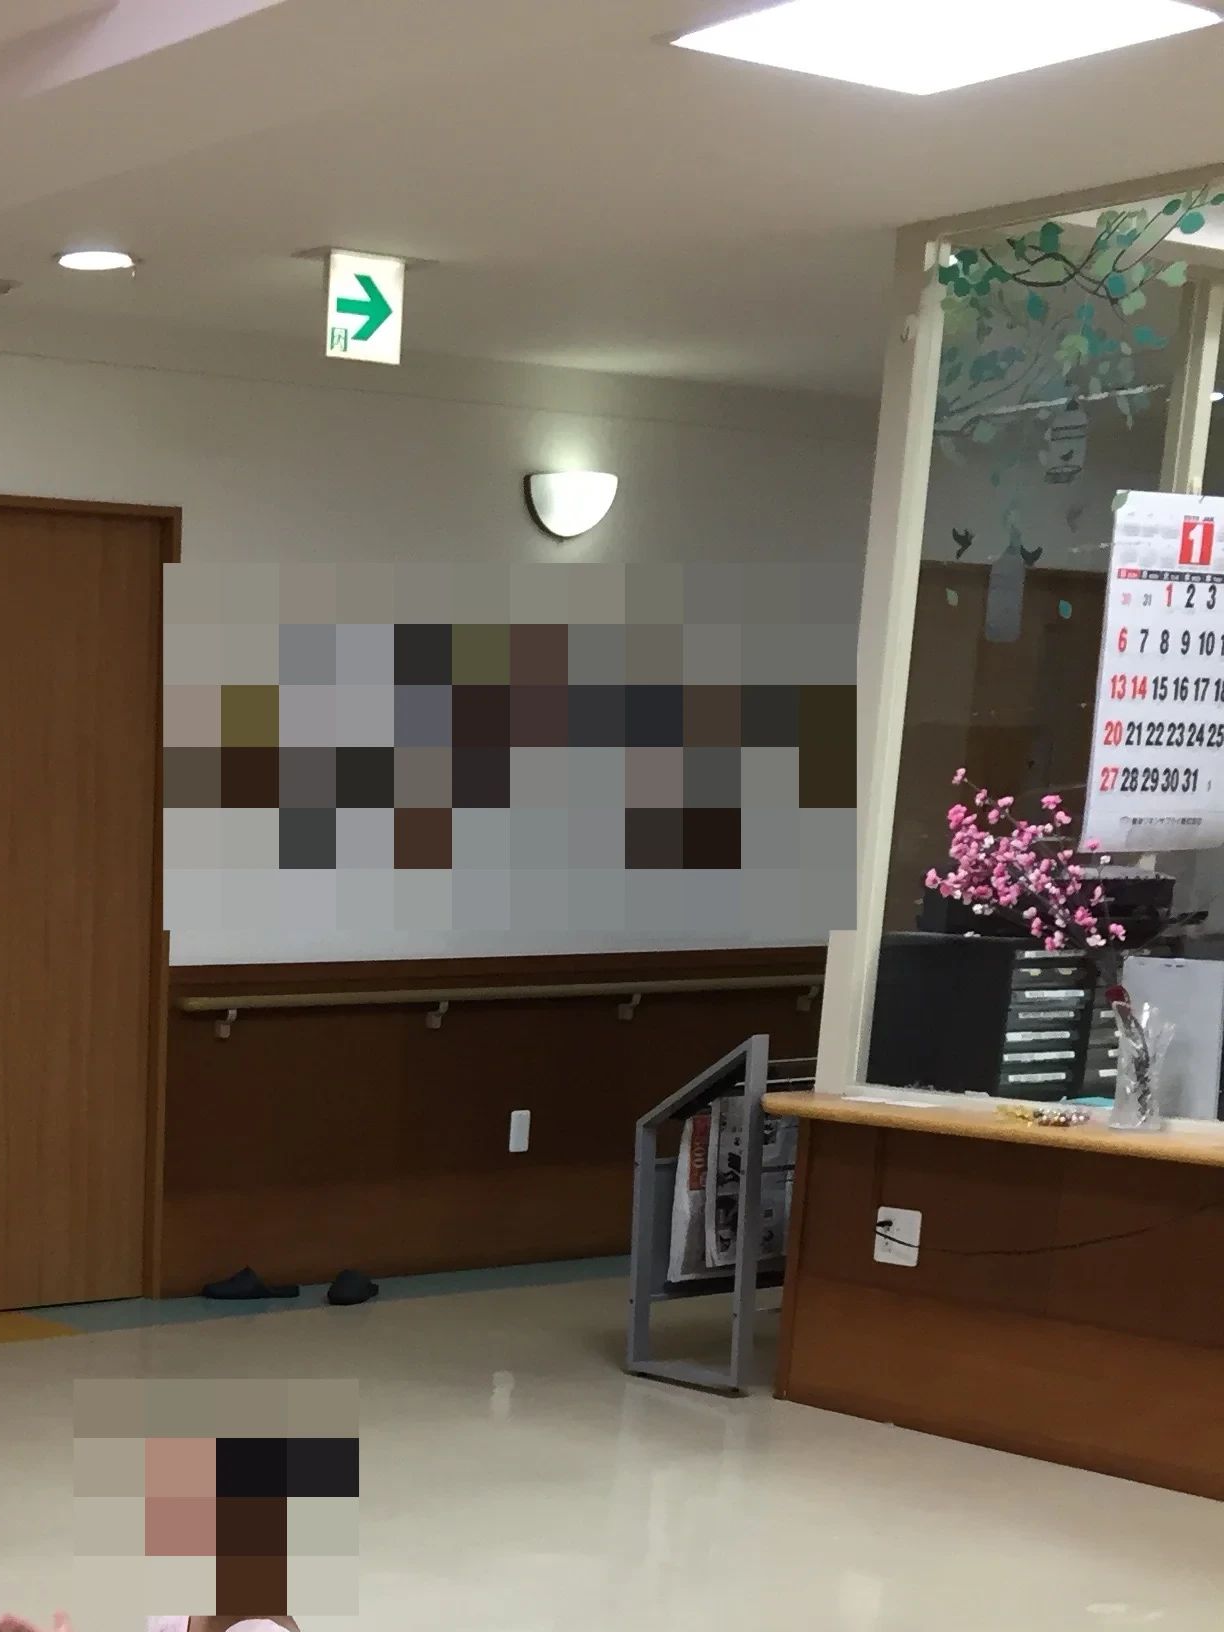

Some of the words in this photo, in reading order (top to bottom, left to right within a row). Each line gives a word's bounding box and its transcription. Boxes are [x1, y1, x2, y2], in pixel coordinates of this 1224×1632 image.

[1189, 524, 1204, 564] 1
[1166, 583, 1173, 607] 1
[1185, 584, 1196, 608] 2
[1206, 584, 1217, 609] 3
[1118, 627, 1127, 652] 6
[1140, 629, 1149, 653] 7
[1160, 629, 1170, 654] 8
[1181, 630, 1191, 655] 9
[1199, 631, 1215, 656] 10
[1111, 674, 1126, 699] 13
[1132, 675, 1147, 699] 14
[1152, 676, 1168, 700] 15
[1173, 676, 1189, 701] 16
[1194, 677, 1210, 702] 17
[1104, 721, 1122, 745] 20
[1125, 721, 1143, 746] 21
[1145, 722, 1164, 746] 22
[1166, 722, 1185, 747] 23
[1186, 723, 1205, 747] 24
[1206, 723, 1224, 748] 25
[1100, 767, 1119, 791] 27
[1120, 767, 1139, 792] 28
[1140, 767, 1159, 792] 29
[1161, 768, 1179, 792] 30
[1182, 768, 1199, 792] 31
